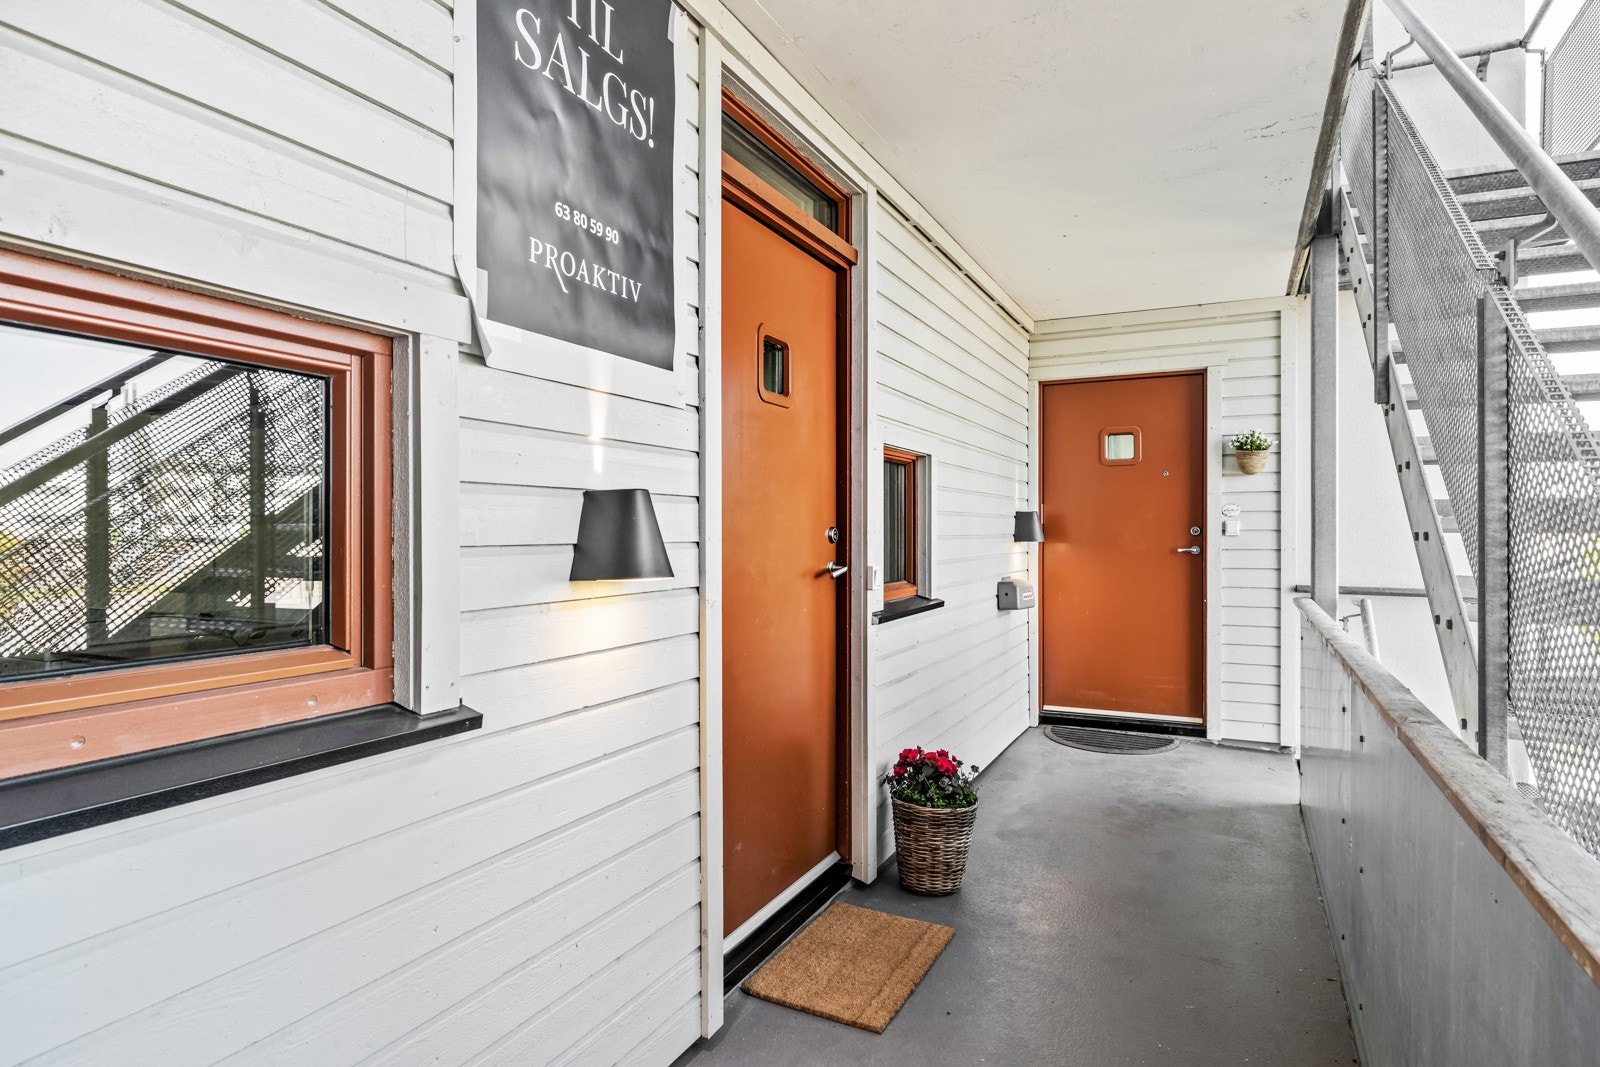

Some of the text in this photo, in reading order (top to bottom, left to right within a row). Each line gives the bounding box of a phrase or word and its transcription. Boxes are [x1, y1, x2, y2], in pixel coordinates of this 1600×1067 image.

[514, 8, 654, 148] SALGS!
[554, 201, 619, 244] 63 80 59 90
[528, 236, 642, 302] PROAKTIV
